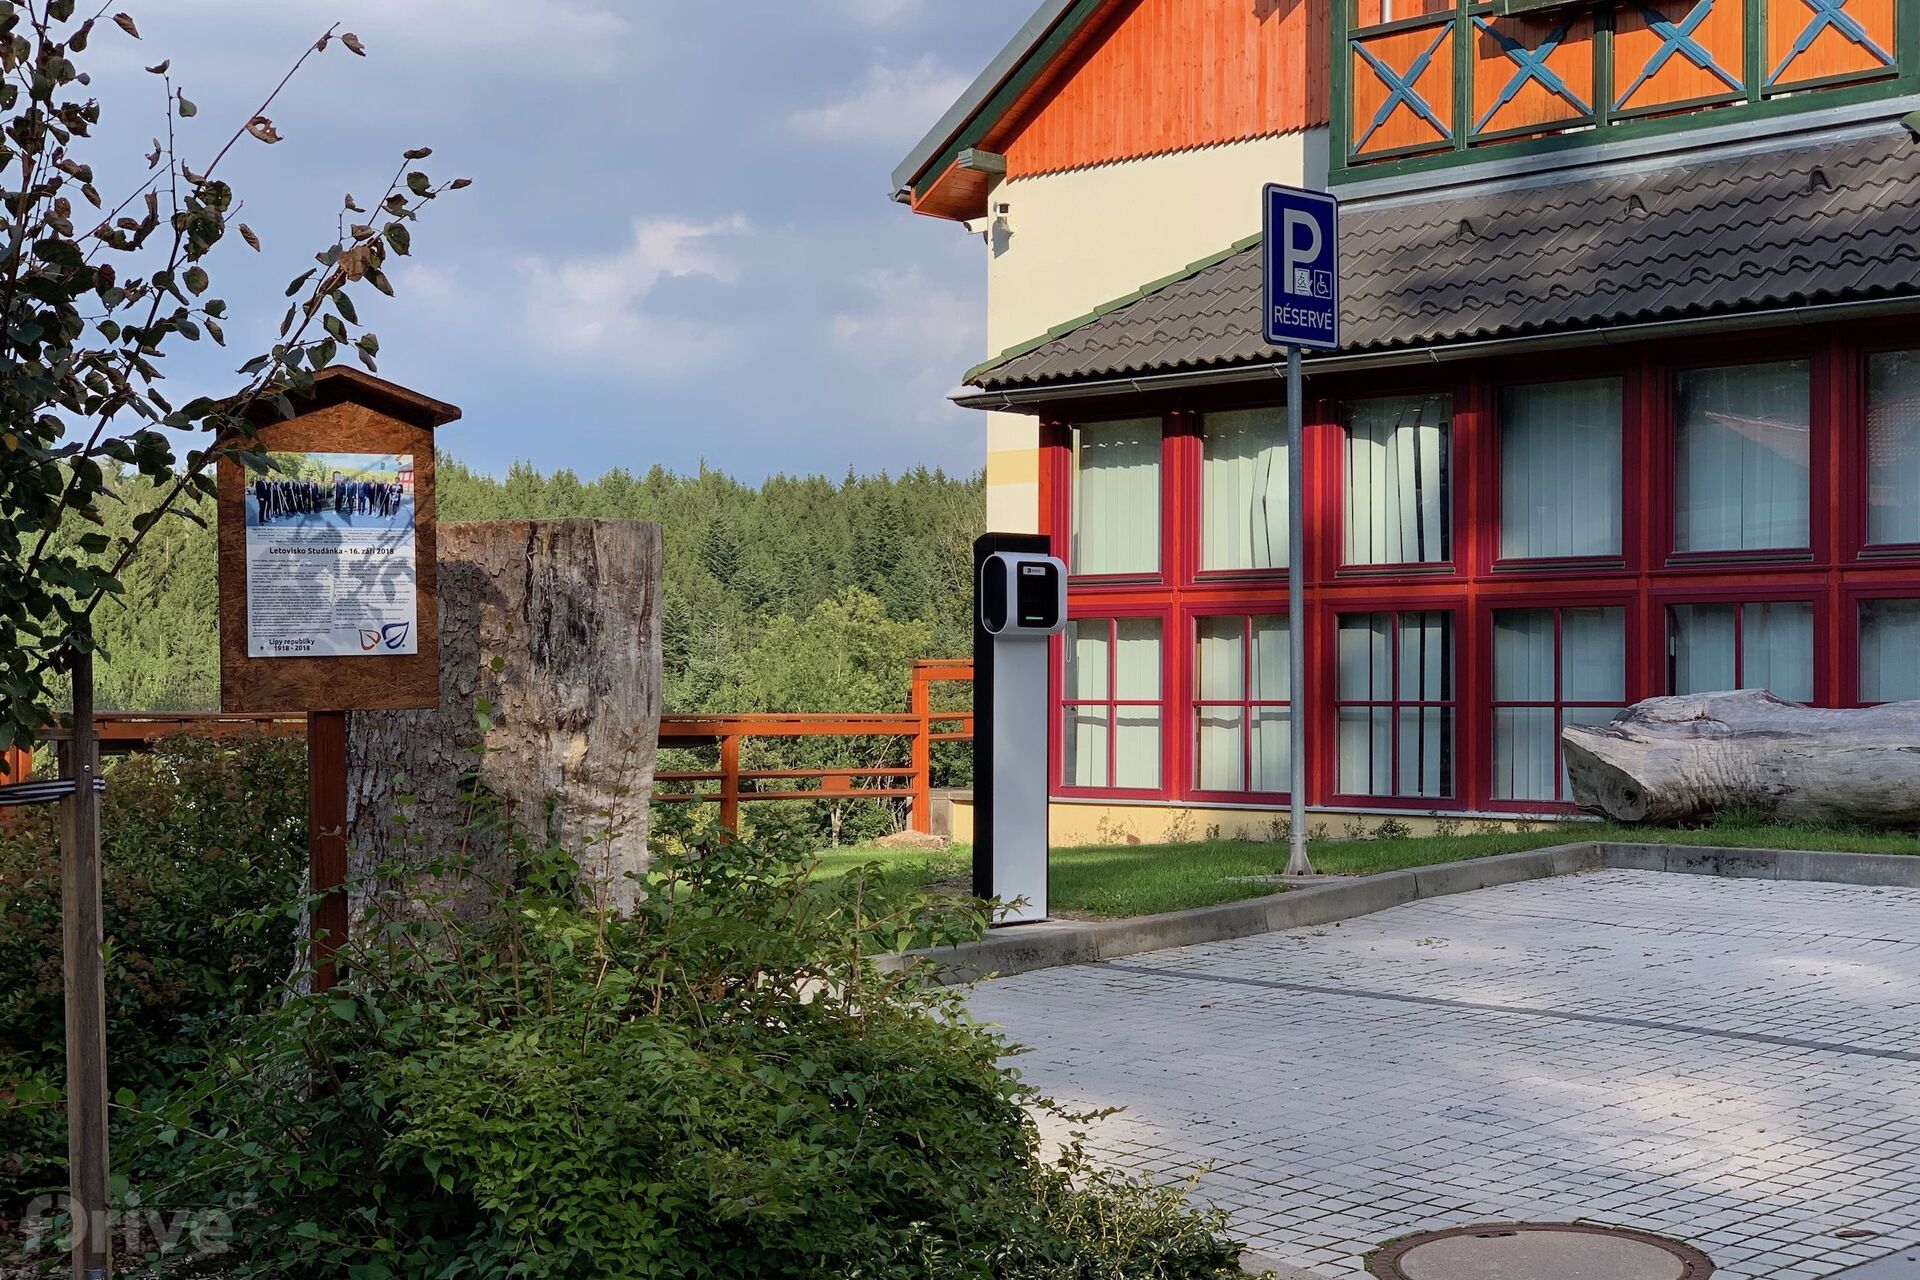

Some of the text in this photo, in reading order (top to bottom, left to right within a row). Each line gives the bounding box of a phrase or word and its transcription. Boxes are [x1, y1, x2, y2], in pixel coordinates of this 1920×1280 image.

[1284, 208, 1322, 295] P
[1274, 302, 1333, 331] RÉSERVÉ
[269, 547, 306, 555] Letovisko
[308, 546, 343, 555] Studánka
[349, 547, 360, 555] 16.
[361, 546, 375, 555] září
[376, 547, 394, 555] 2018
[284, 638, 315, 646] republiky
